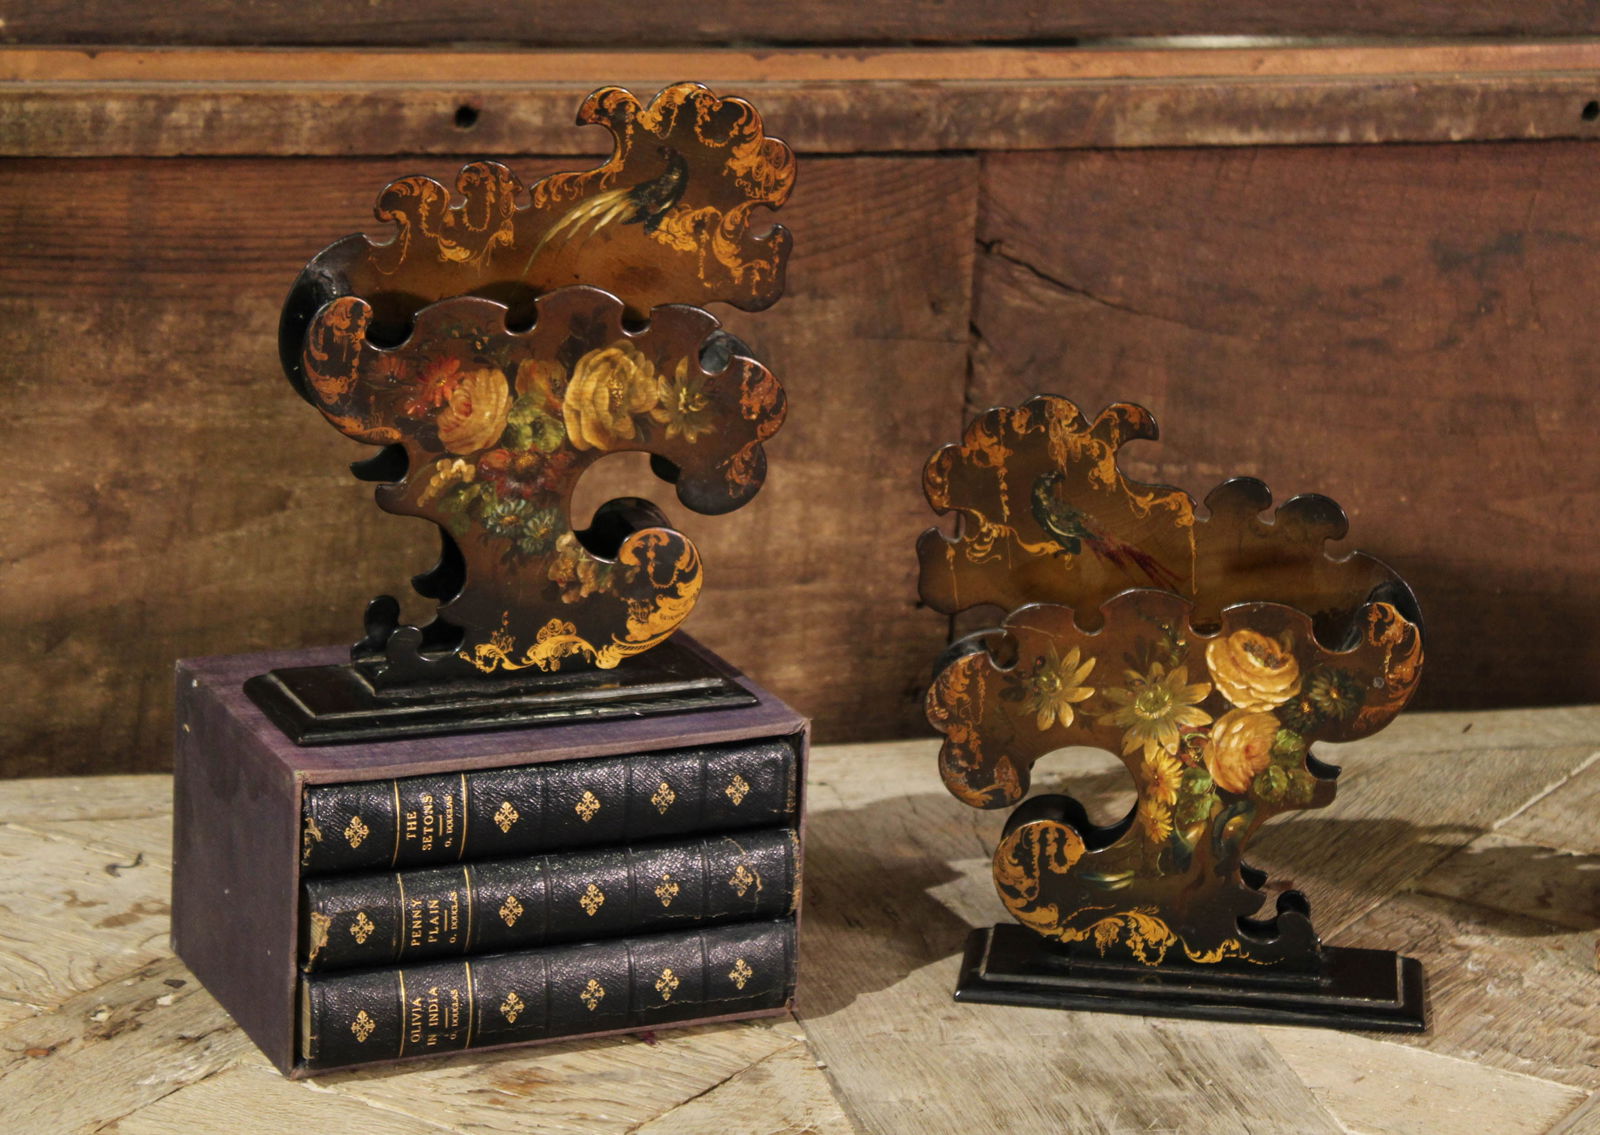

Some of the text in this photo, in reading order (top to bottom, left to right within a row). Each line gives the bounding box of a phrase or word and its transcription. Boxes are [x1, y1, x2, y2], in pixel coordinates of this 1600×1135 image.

[406, 811, 417, 840] THE
[422, 795, 434, 851] SETONS
[445, 795, 454, 834] DOUGLAS
[410, 899, 422, 946] PENNY
[428, 900, 439, 943] PLAIN
[451, 891, 459, 930] DOUGLAS
[411, 997, 423, 1043] OLIVIA
[426, 986, 439, 1046] IN INDIA
[451, 989, 459, 1027] DOUGLAS
